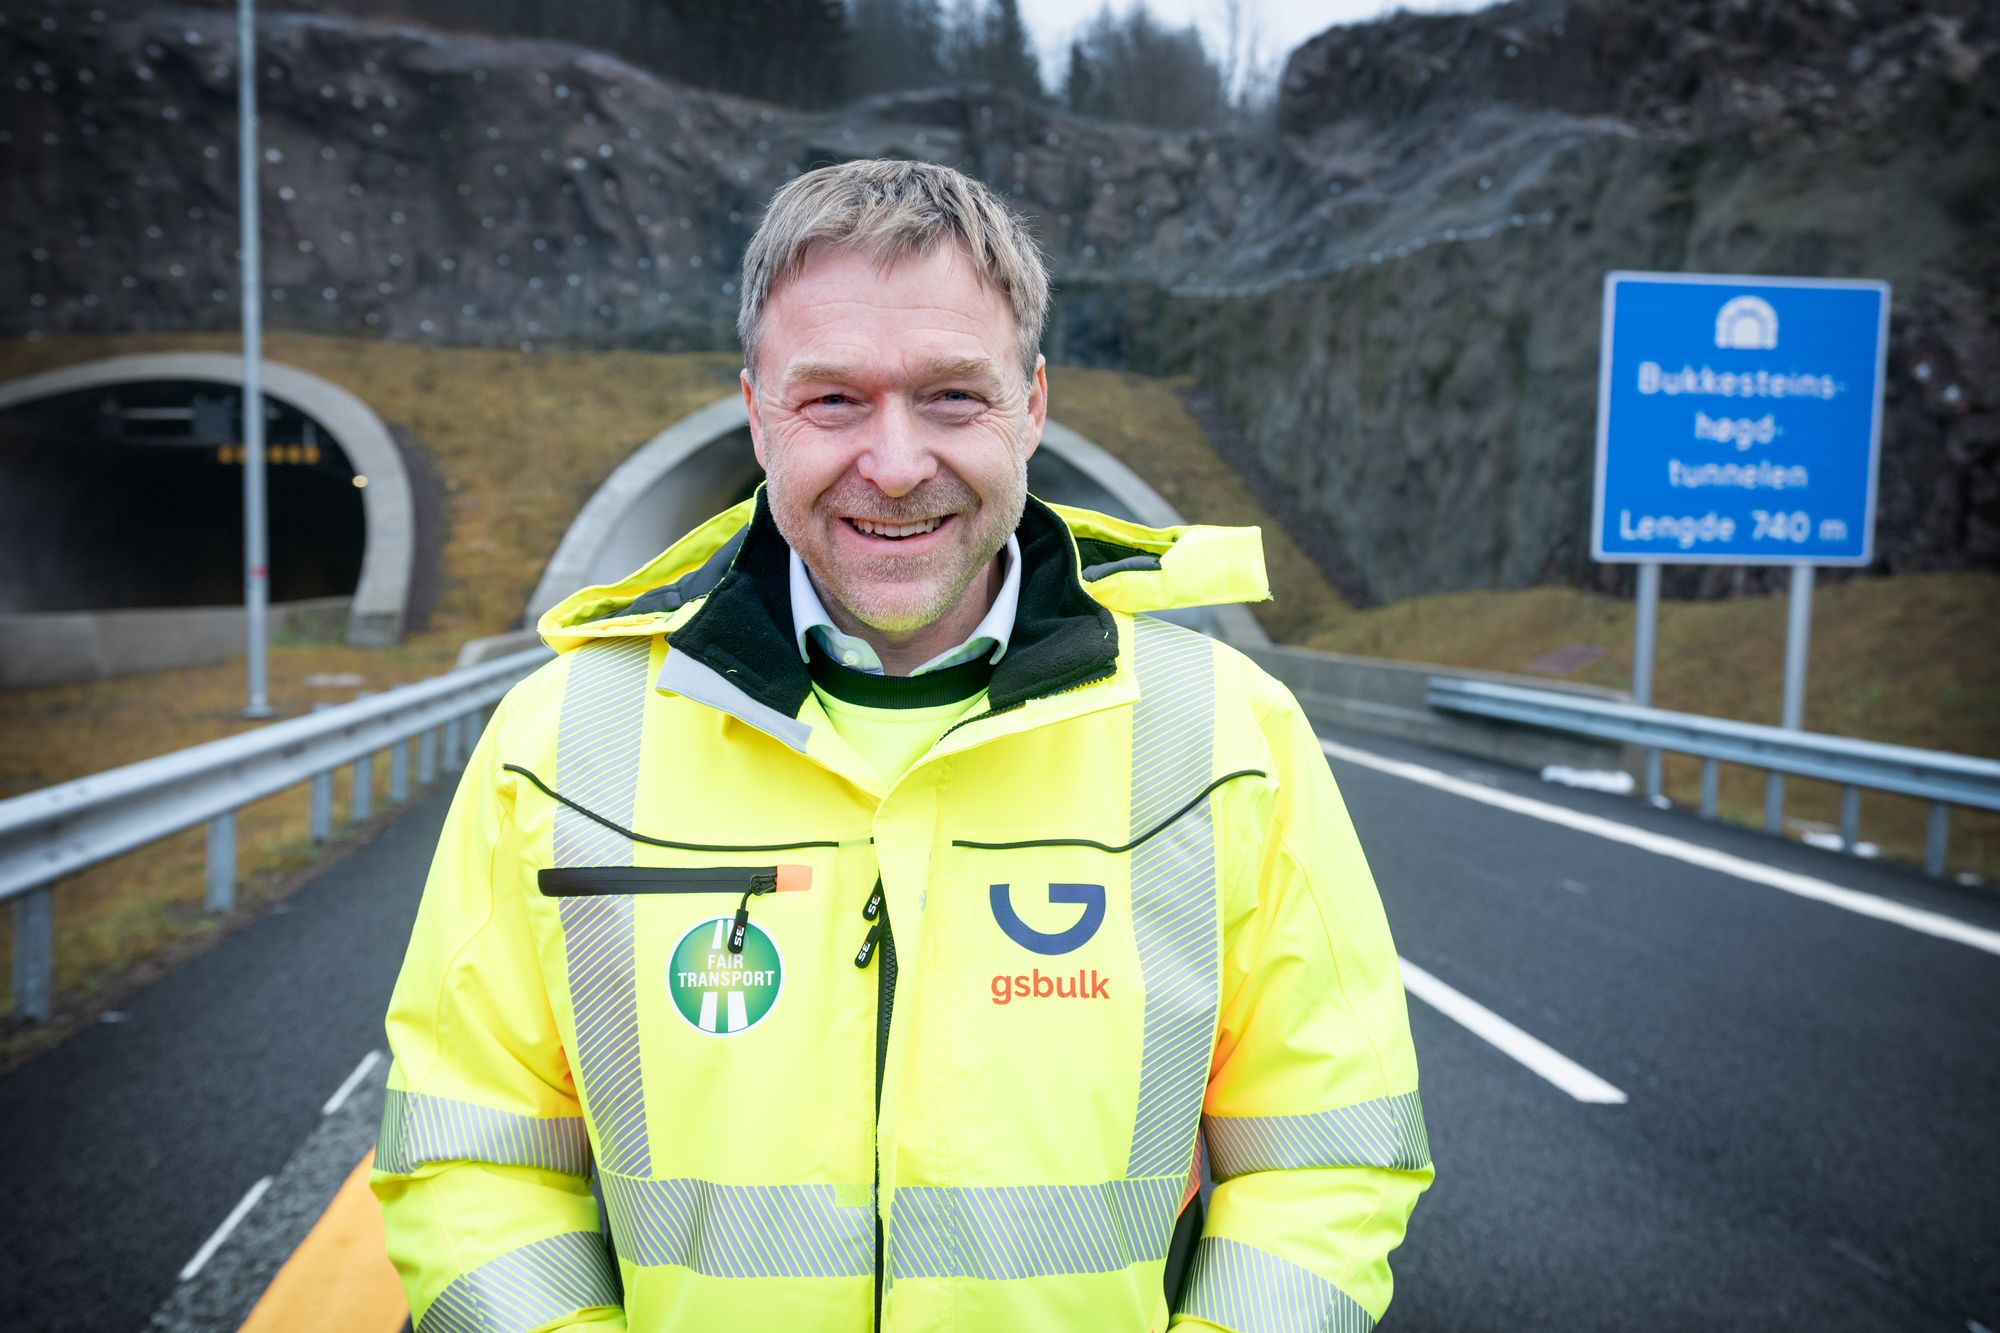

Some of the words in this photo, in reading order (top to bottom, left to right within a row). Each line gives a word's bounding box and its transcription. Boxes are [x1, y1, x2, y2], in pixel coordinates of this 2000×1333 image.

[1637, 361, 1845, 399] Bukkesteins-
[1695, 411, 1783, 451] høgd-
[1669, 459, 1808, 489] tunnelen
[1620, 509, 1736, 548] Lengde
[1751, 510, 1811, 543] 740
[1818, 518, 1848, 541] m
[677, 970, 775, 988] TRANSPORT
[707, 954, 744, 970] FAIR
[990, 968, 1110, 1005] gsbulk
